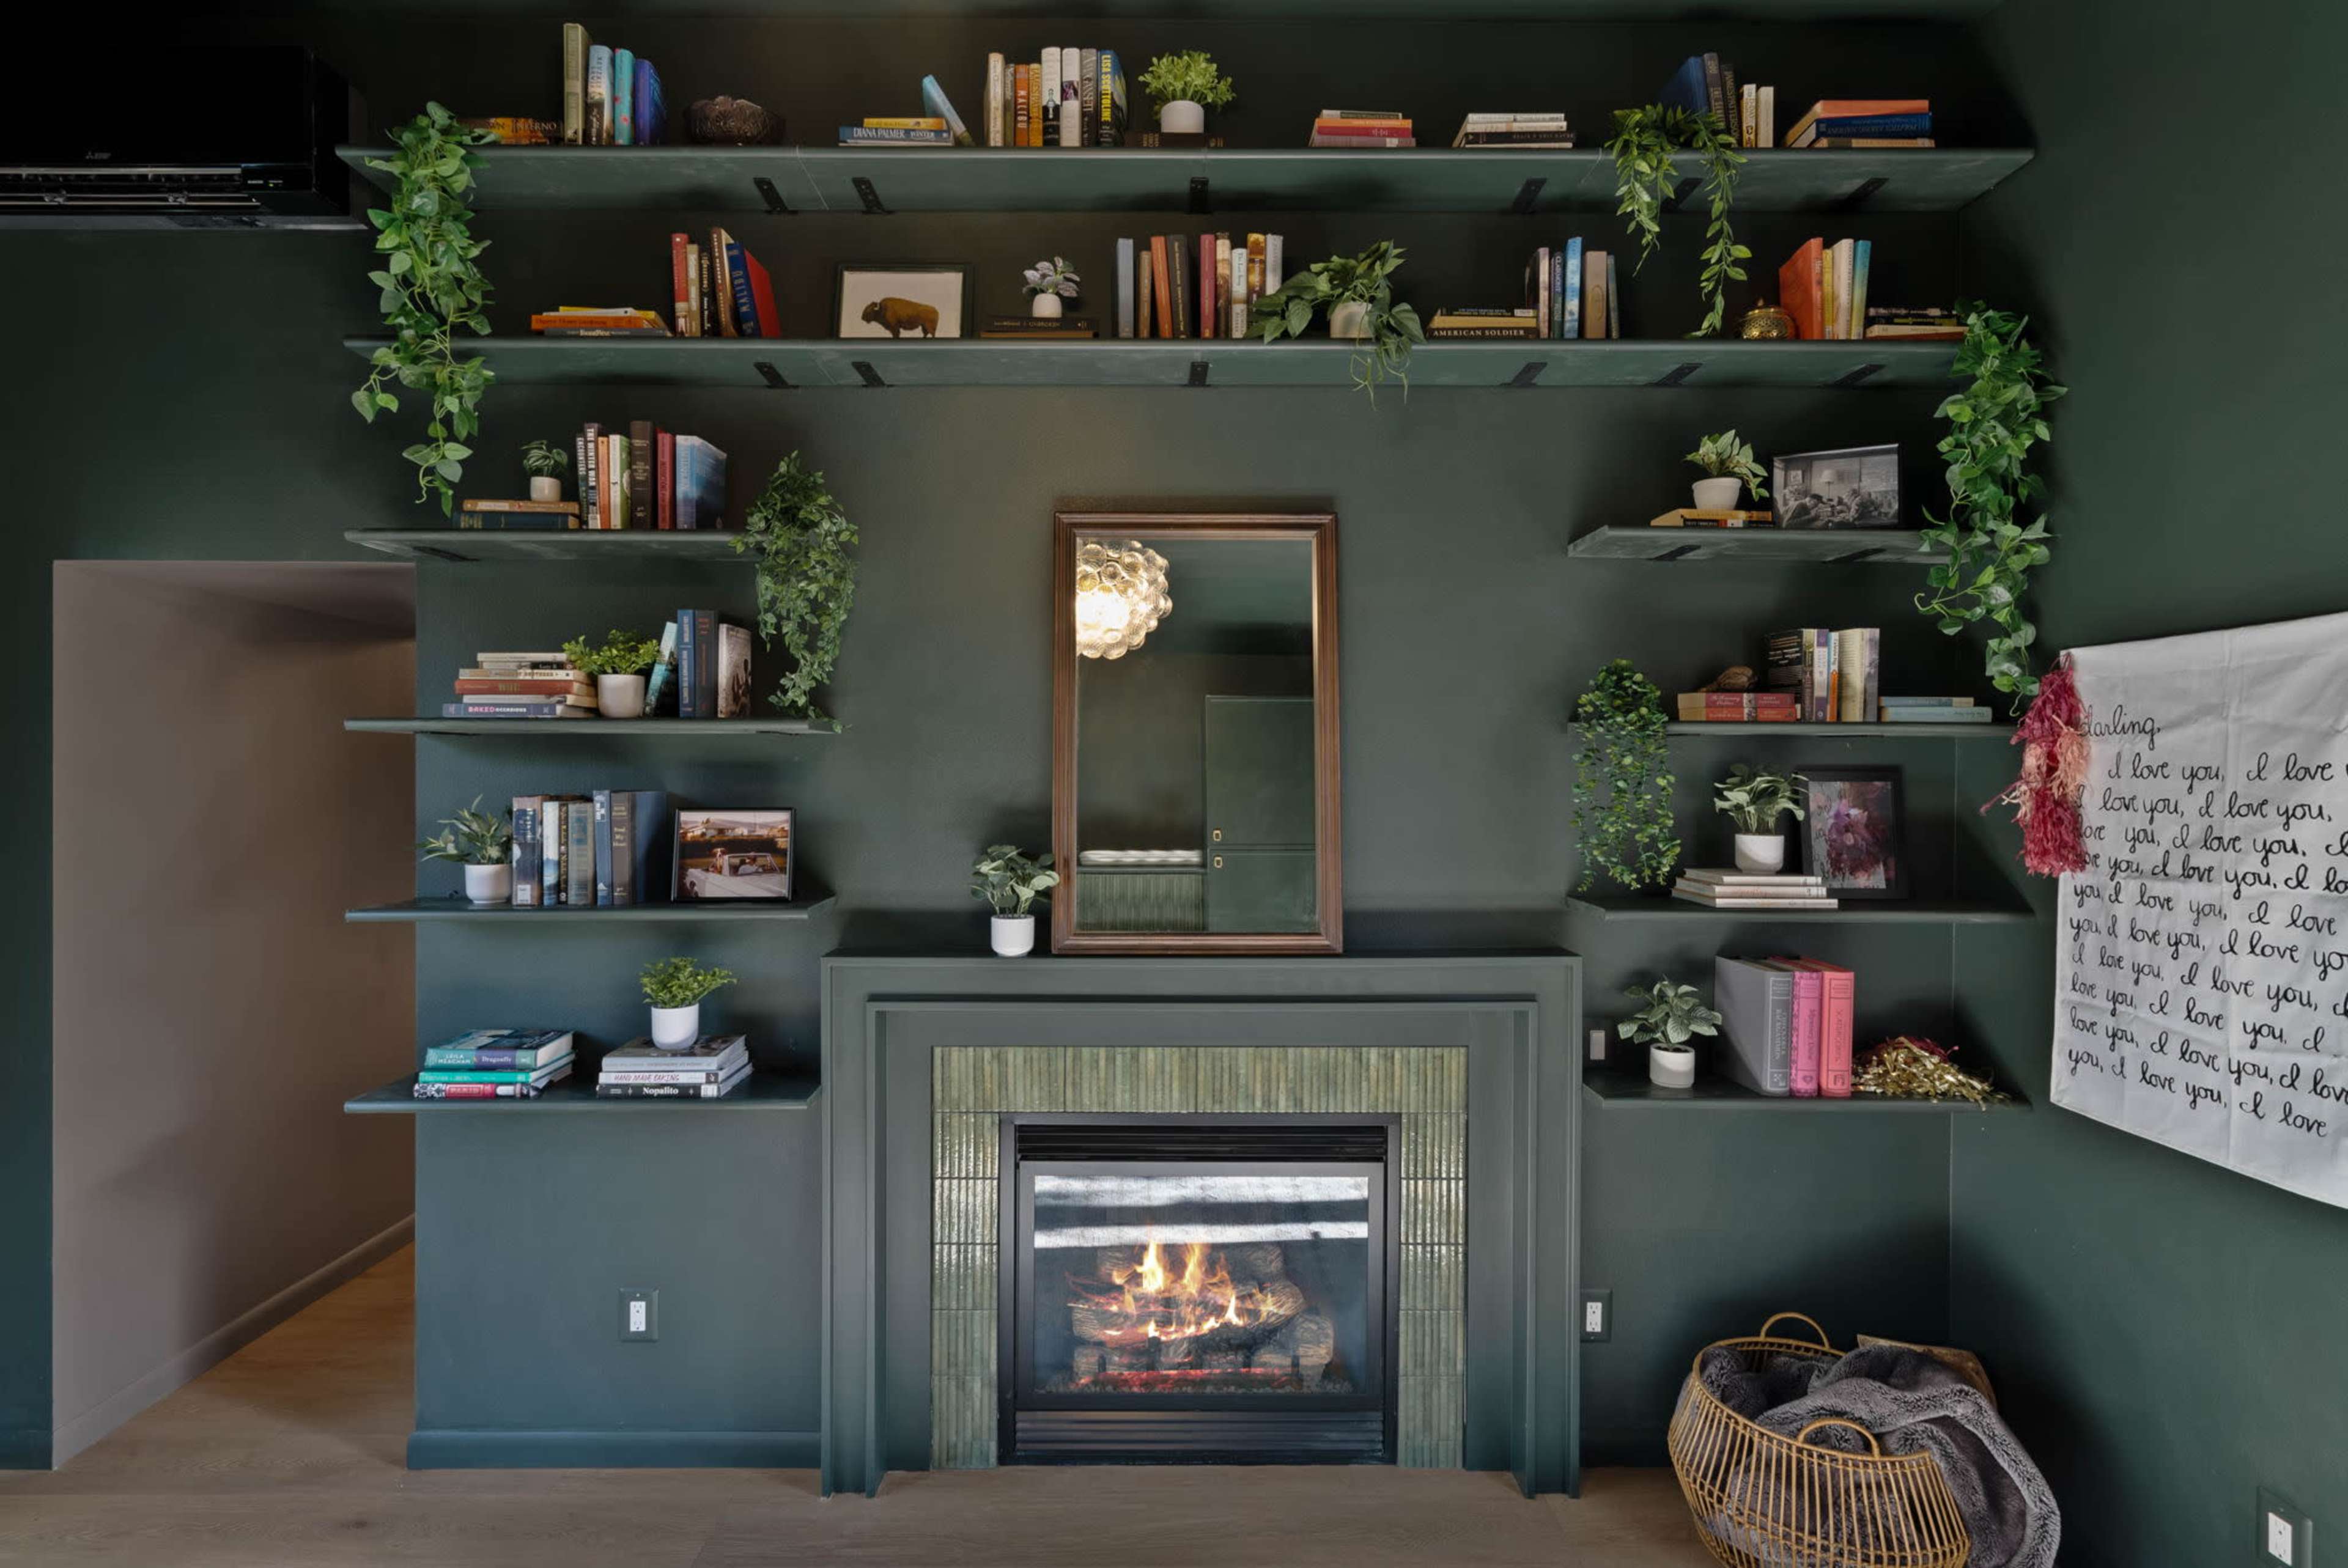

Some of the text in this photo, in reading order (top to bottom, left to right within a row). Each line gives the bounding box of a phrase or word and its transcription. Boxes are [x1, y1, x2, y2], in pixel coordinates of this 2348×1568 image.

[1102, 54, 1112, 73] LISA
[1017, 90, 1028, 128] MALIBU
[1102, 74, 1112, 122] SCOTTOLINE
[512, 118, 557, 133] INFERNO
[853, 127, 877, 138] DIANA
[877, 128, 905, 139] PALMER
[587, 442, 596, 468] WINTER
[2108, 752, 2121, 779] I
[2130, 753, 2170, 779] love
[2182, 765, 2224, 795] you,
[2246, 752, 2267, 781] I
[2283, 753, 2334, 781] love
[2099, 787, 2139, 812] love
[2143, 798, 2185, 825] you,
[2199, 790, 2214, 818] I
[2223, 791, 2269, 818] love
[2276, 804, 2332, 831] you,
[2124, 826, 2160, 853] you,
[2173, 823, 2188, 848] I
[2199, 825, 2242, 853] love
[2108, 856, 2143, 882] you,
[2151, 850, 2170, 877] I
[2179, 853, 2214, 882] love
[2284, 863, 2310, 889] I
[2108, 881, 2124, 904] I
[2135, 882, 2174, 911] love
[2189, 900, 2228, 927] you,
[2248, 900, 2270, 925] I
[2284, 904, 2337, 935] love
[2108, 914, 2118, 939] I
[2128, 917, 2161, 946] love
[2167, 932, 2206, 960] you,
[2219, 929, 2239, 955] I
[2246, 930, 2300, 963] love
[2314, 949, 2348, 981] yo
[2072, 942, 2084, 965] I
[2098, 945, 2124, 970] love
[2180, 962, 2199, 986] I
[2210, 965, 2254, 997] love
[2267, 984, 2318, 1012] you,
[2070, 972, 2097, 999] love
[2149, 990, 2169, 1015] I
[2184, 996, 2224, 1030] love
[2302, 1026, 2325, 1052] I
[2070, 1006, 2097, 1036] love
[2105, 1025, 2139, 1052] you,
[2150, 1031, 2168, 1055] I
[2178, 1039, 2220, 1072] love
[2228, 1057, 2273, 1086] you,
[2279, 1062, 2300, 1091] I
[642, 1086, 679, 1097] Nopalito
[2069, 1048, 2328, 1138] you, I love you, I love
